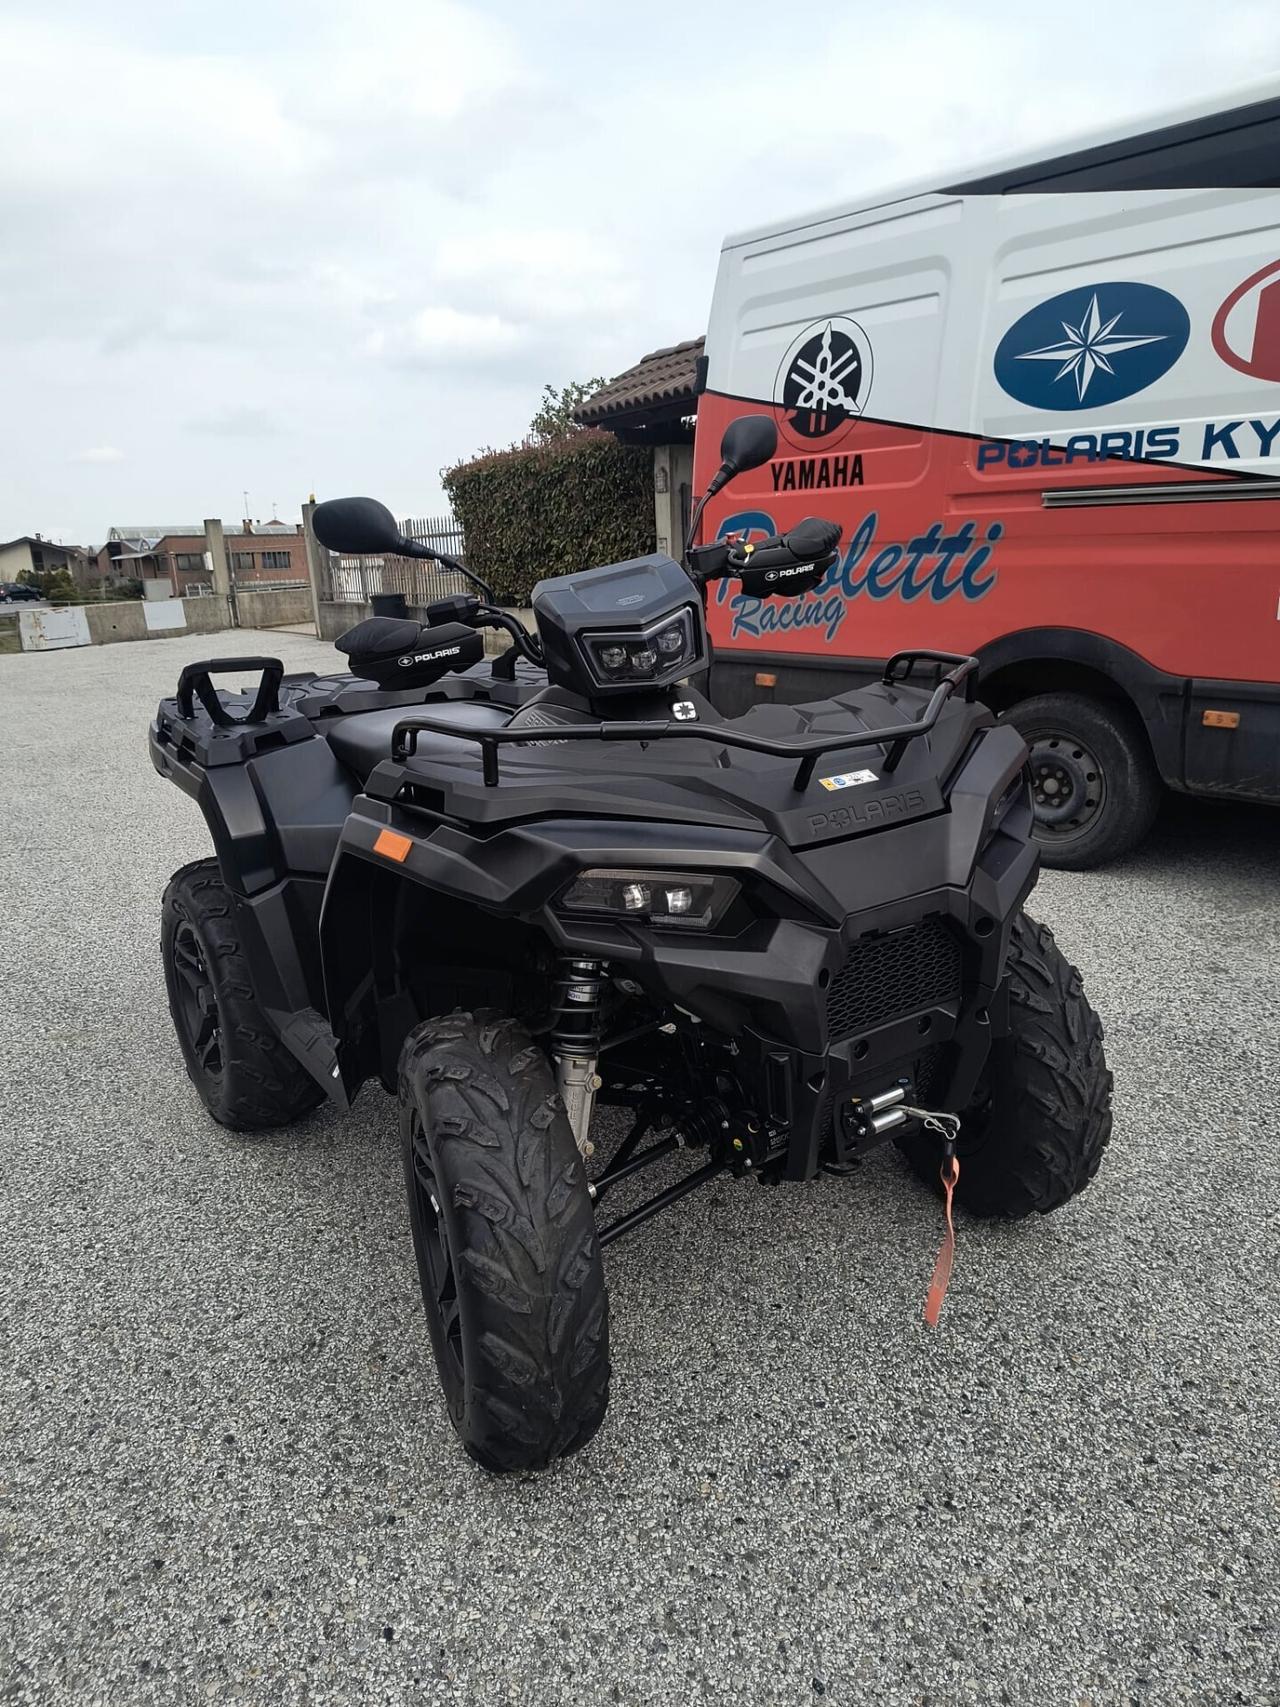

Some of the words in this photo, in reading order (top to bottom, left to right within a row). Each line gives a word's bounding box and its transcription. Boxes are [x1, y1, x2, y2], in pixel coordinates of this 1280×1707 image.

[977, 426, 1180, 472] POLARIS
[770, 454, 864, 492] YAMAHA
[779, 563, 815, 578] POLARIS
[730, 594, 846, 640] Racing
[414, 646, 461, 663] POLARIS
[806, 790, 925, 836] POLARIS
